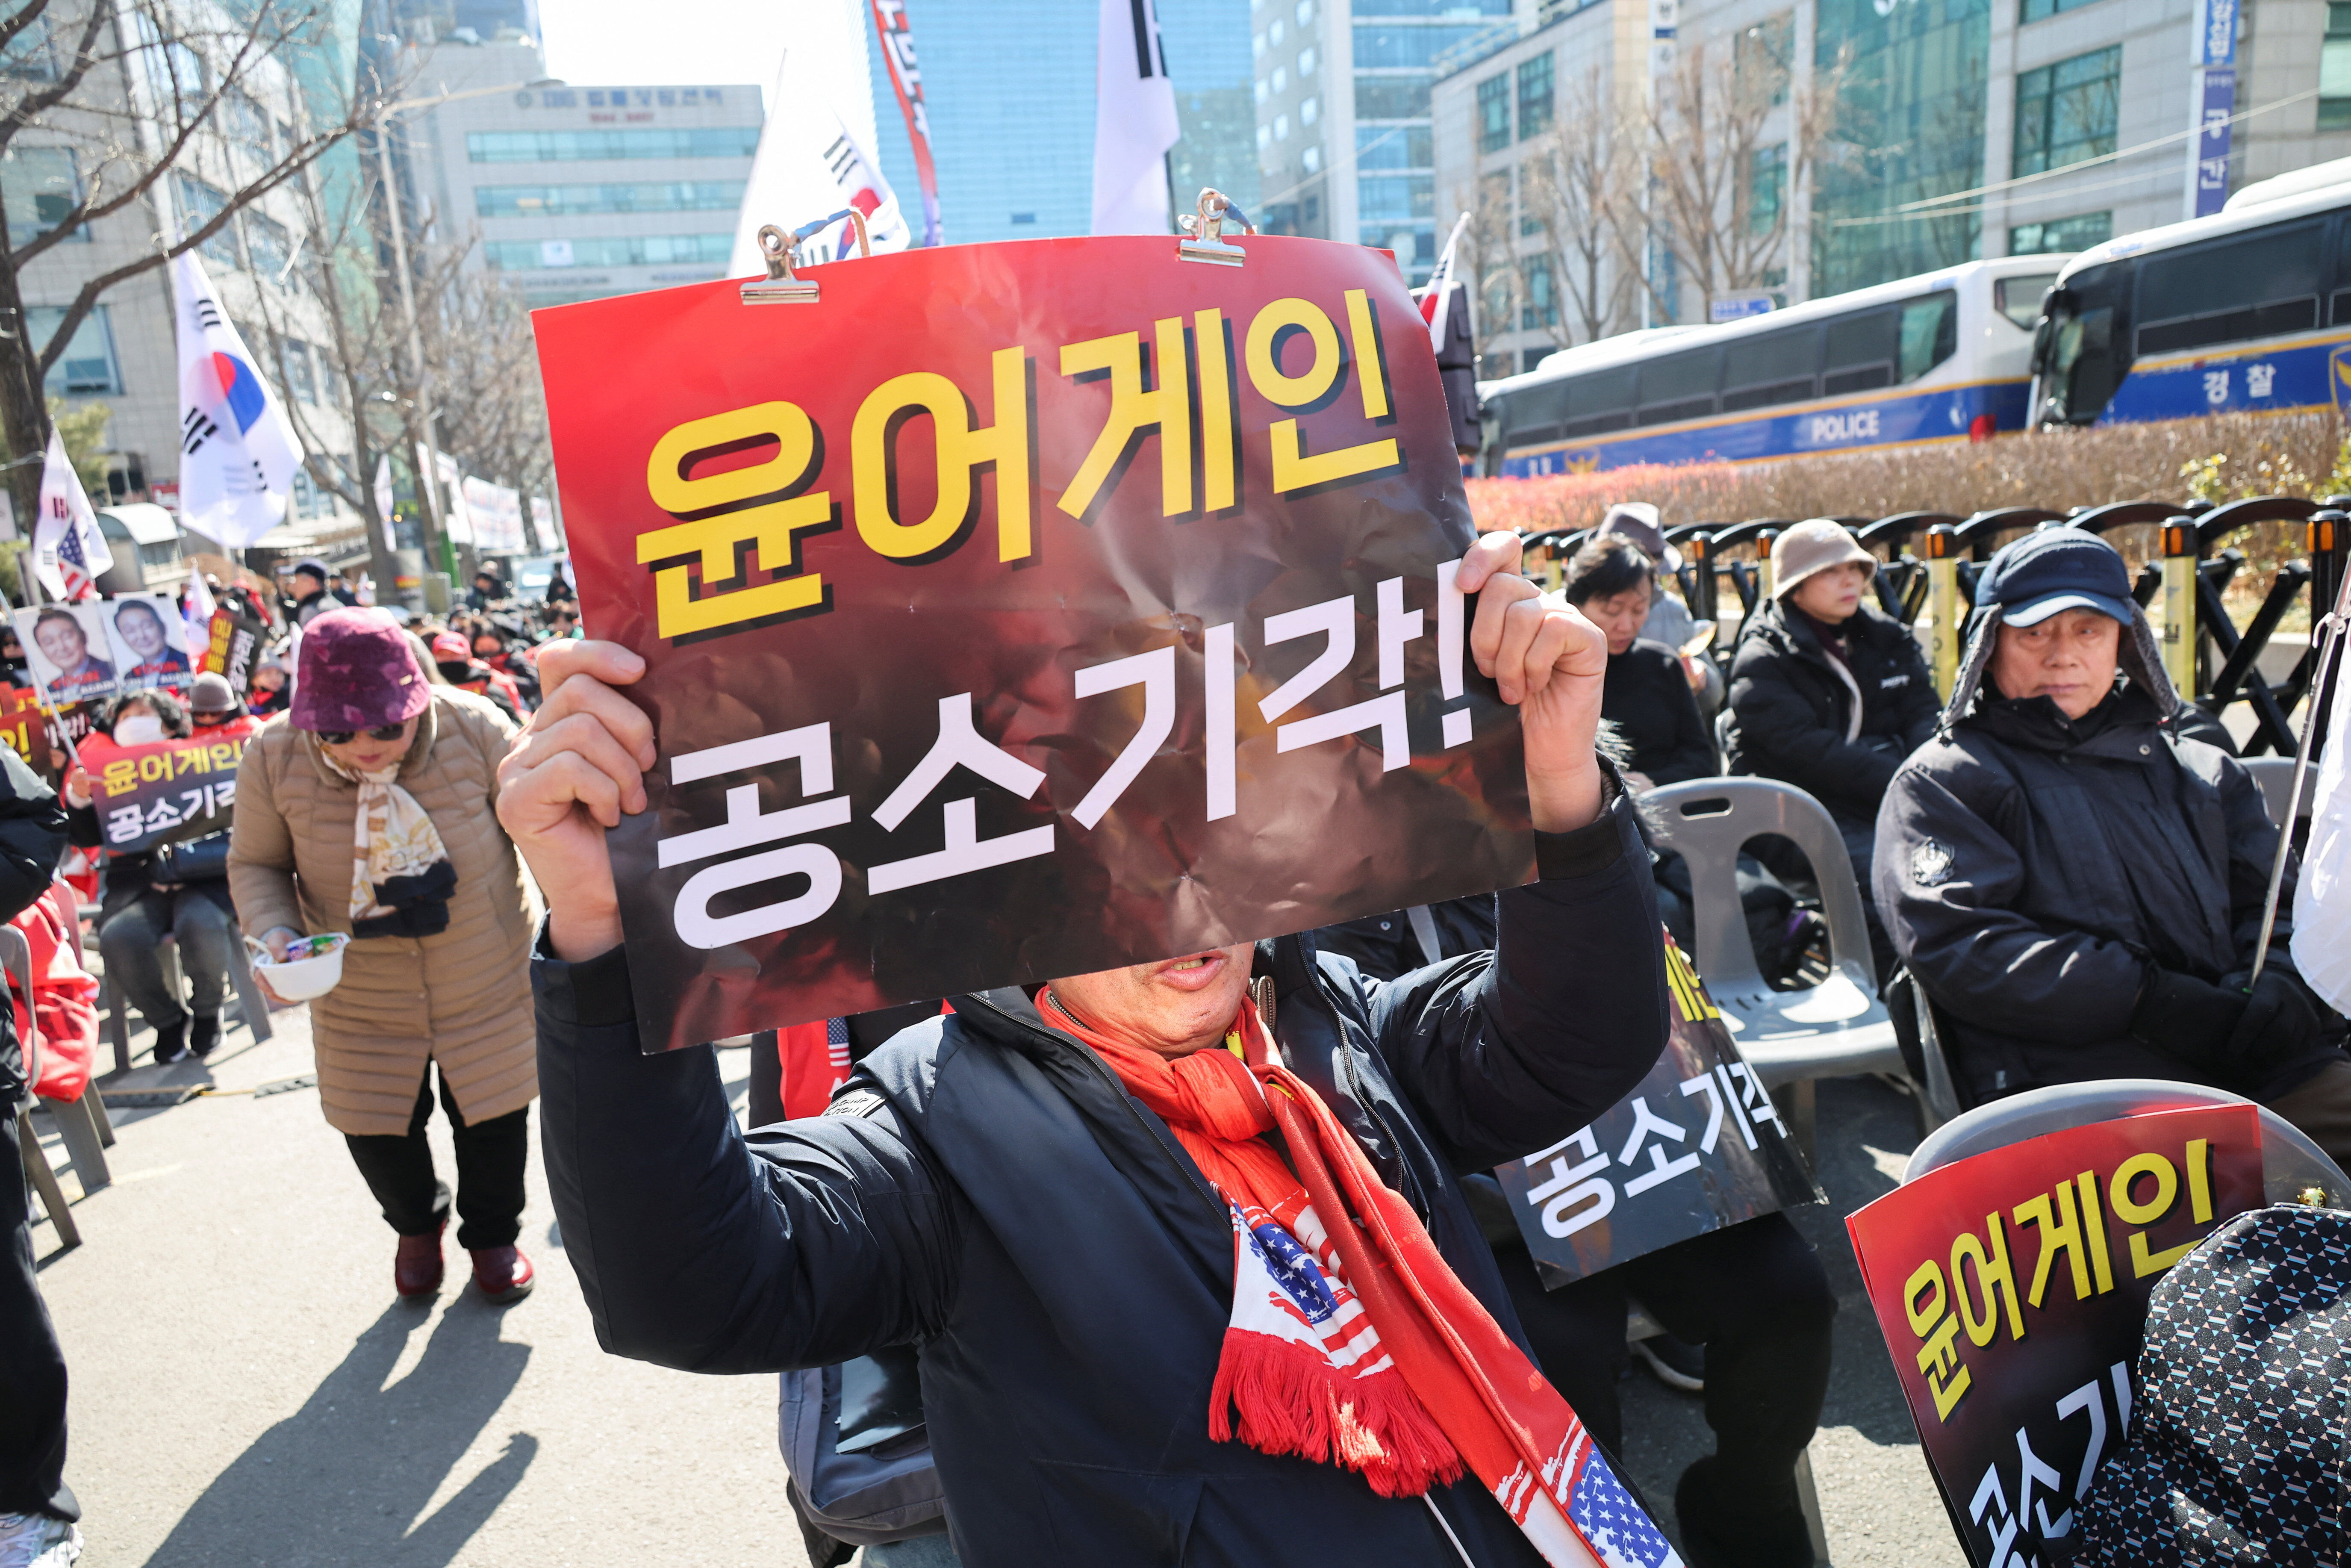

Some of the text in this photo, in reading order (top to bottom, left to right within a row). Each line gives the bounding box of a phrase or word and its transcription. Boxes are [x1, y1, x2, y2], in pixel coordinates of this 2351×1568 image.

[636, 289, 1400, 640] 윤어게인
[1812, 409, 1880, 443] POLICE
[102, 739, 243, 798] 윤어게인
[658, 559, 1474, 950] 공소기각!
[1904, 1138, 2214, 1424] 윤어게인
